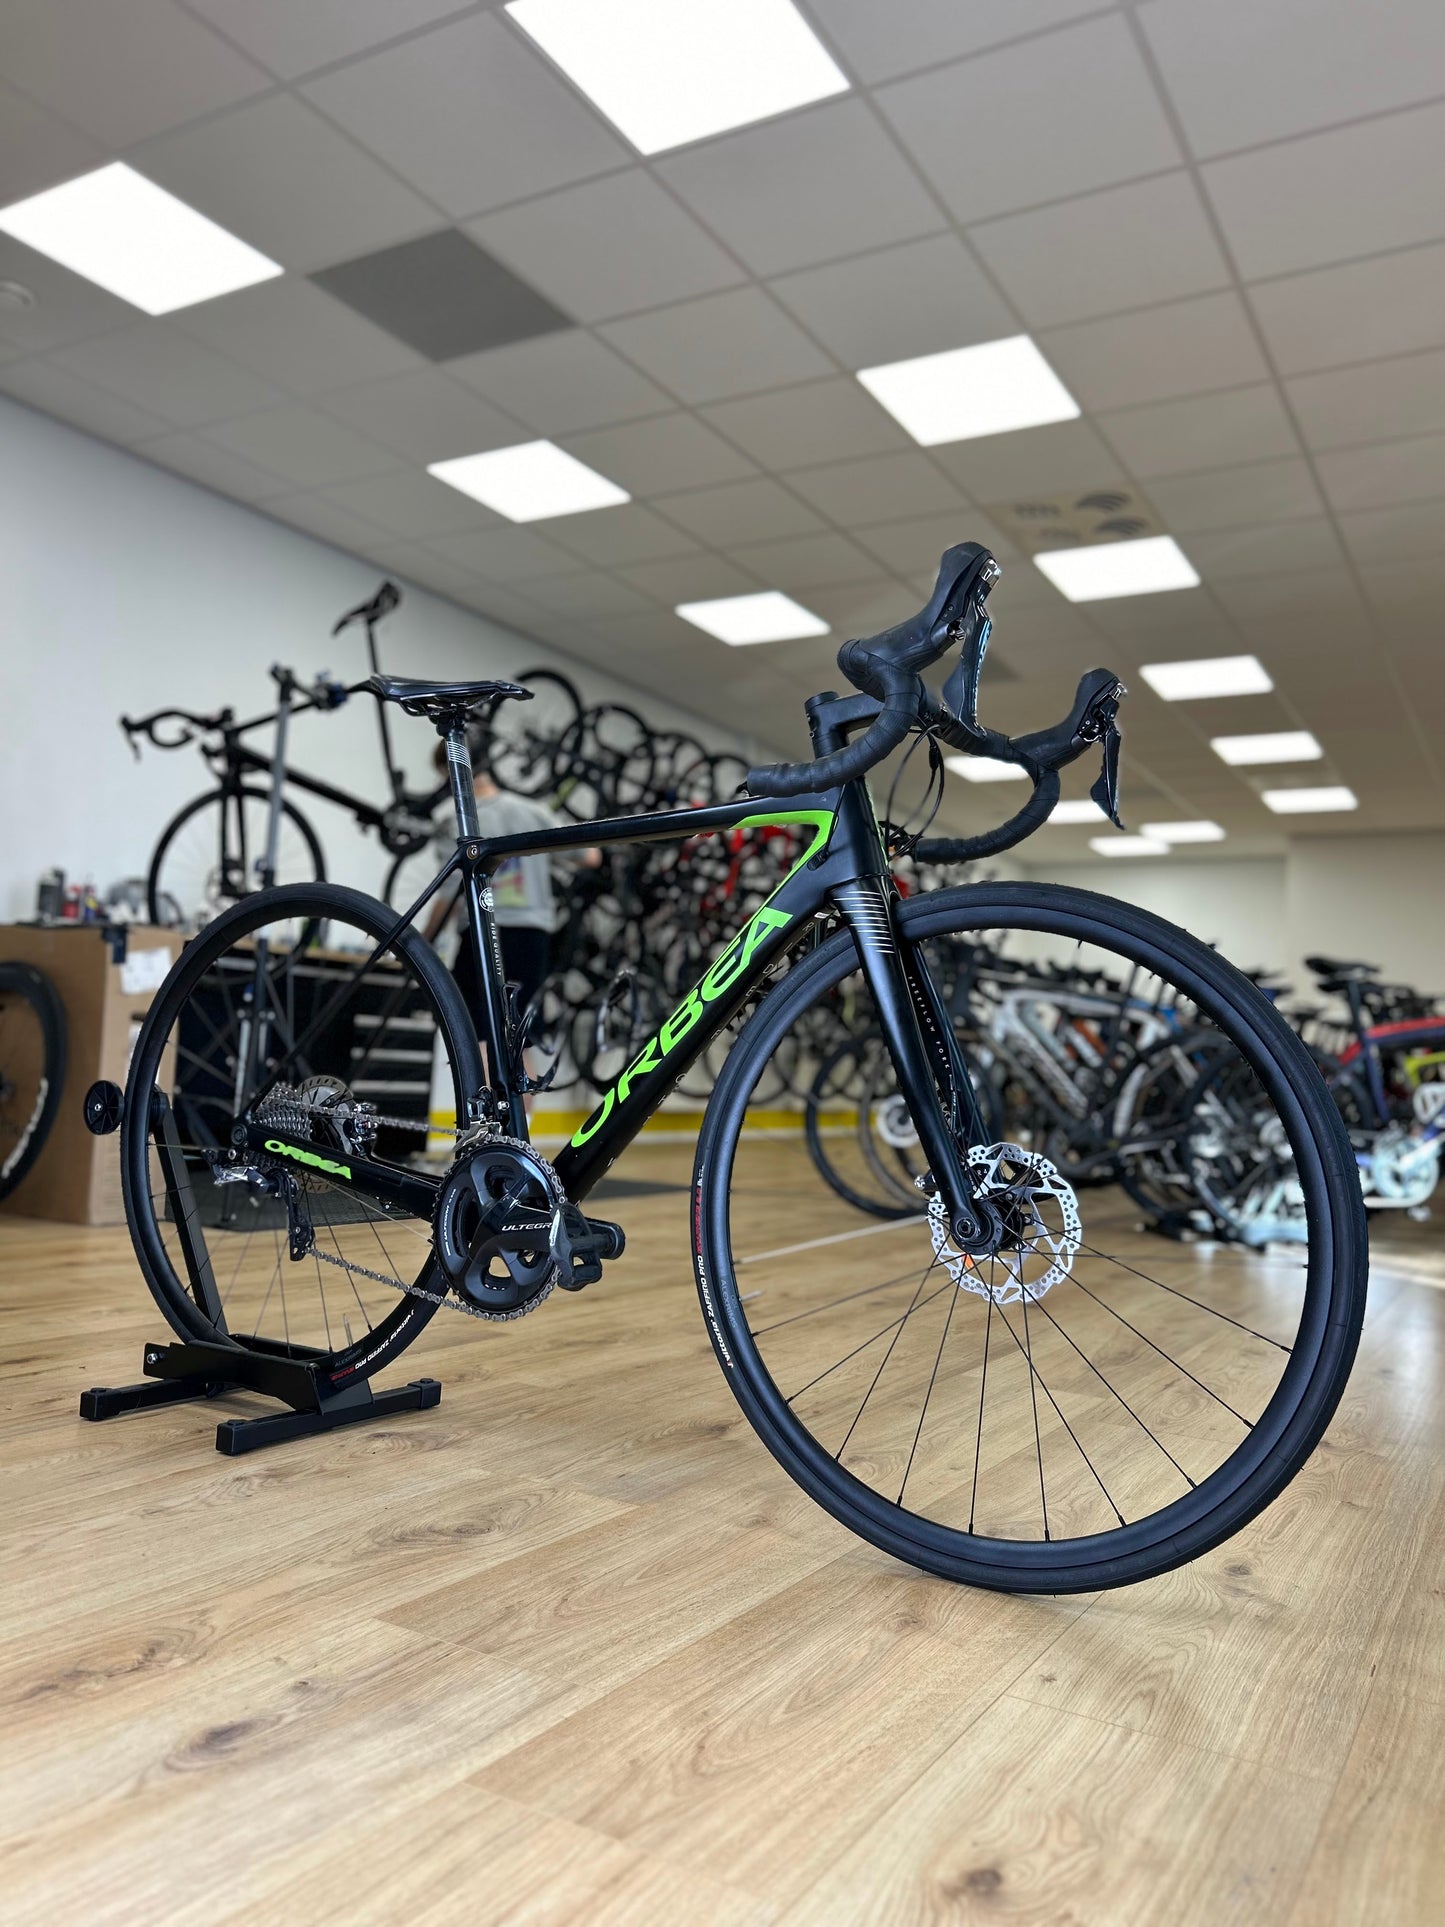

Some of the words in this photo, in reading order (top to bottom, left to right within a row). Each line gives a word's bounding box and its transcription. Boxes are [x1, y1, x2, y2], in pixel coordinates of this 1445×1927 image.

[571, 907, 793, 1147] ORBEA
[907, 976, 936, 1032] FREEFLOW
[935, 1041, 951, 1069] FORK
[501, 1222, 553, 1232] ULTEGR
[697, 1255, 706, 1276] PRO
[700, 1278, 715, 1318] ZAFFIRO
